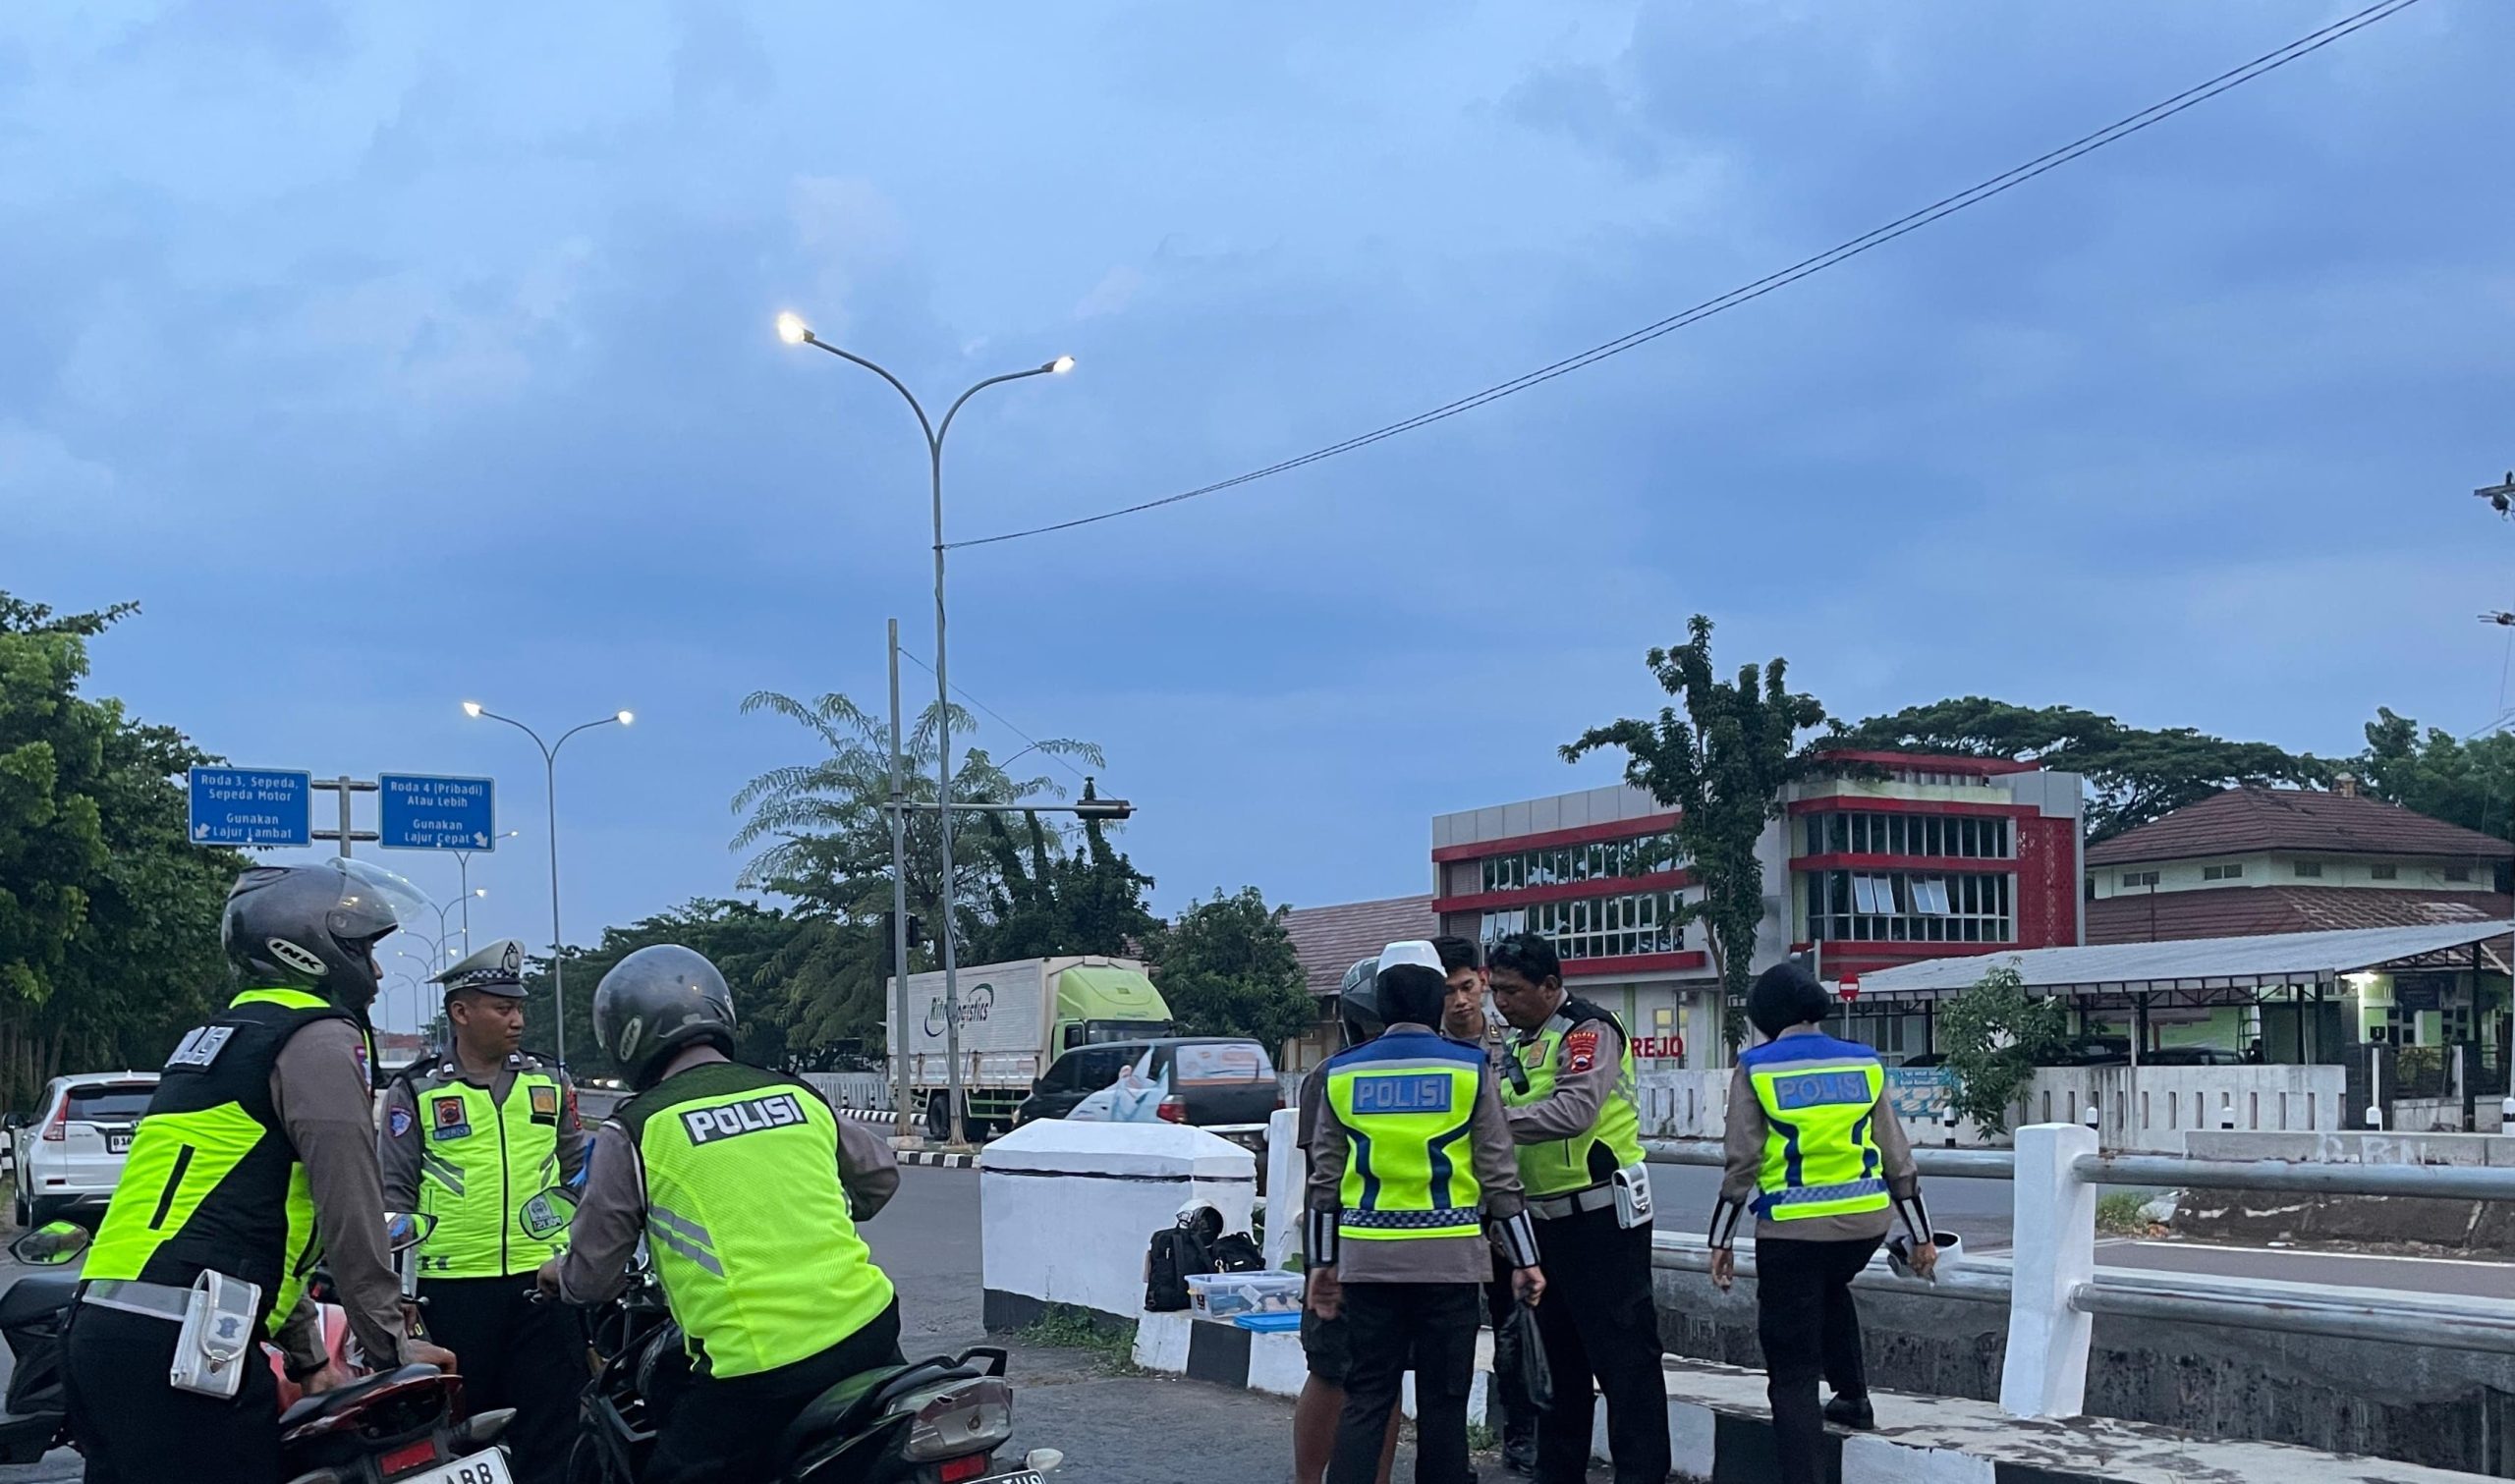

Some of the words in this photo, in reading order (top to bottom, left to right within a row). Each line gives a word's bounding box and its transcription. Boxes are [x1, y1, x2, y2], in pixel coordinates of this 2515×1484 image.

[201, 774, 232, 786] Roda
[252, 776, 299, 790] Sepeda,
[391, 782, 419, 793] Roda
[422, 784, 429, 793] 4
[434, 783, 482, 796] (Pribadi)
[208, 788, 252, 801] Sepeda
[258, 790, 292, 801] Motor
[408, 796, 433, 806] Atau
[438, 797, 468, 807] Lebih
[226, 812, 279, 825] Gunakan
[413, 818, 463, 831] Gunakan
[213, 826, 243, 840] Lajur
[249, 827, 292, 839] Lambat
[405, 832, 432, 845] Lajur
[437, 833, 470, 845] Cepat
[271, 942, 321, 970] INK
[957, 995, 989, 1029] ogistics
[1358, 1078, 1446, 1109] POLISI
[1776, 1072, 1871, 1107] POLISI
[685, 1094, 804, 1142] POLISI
